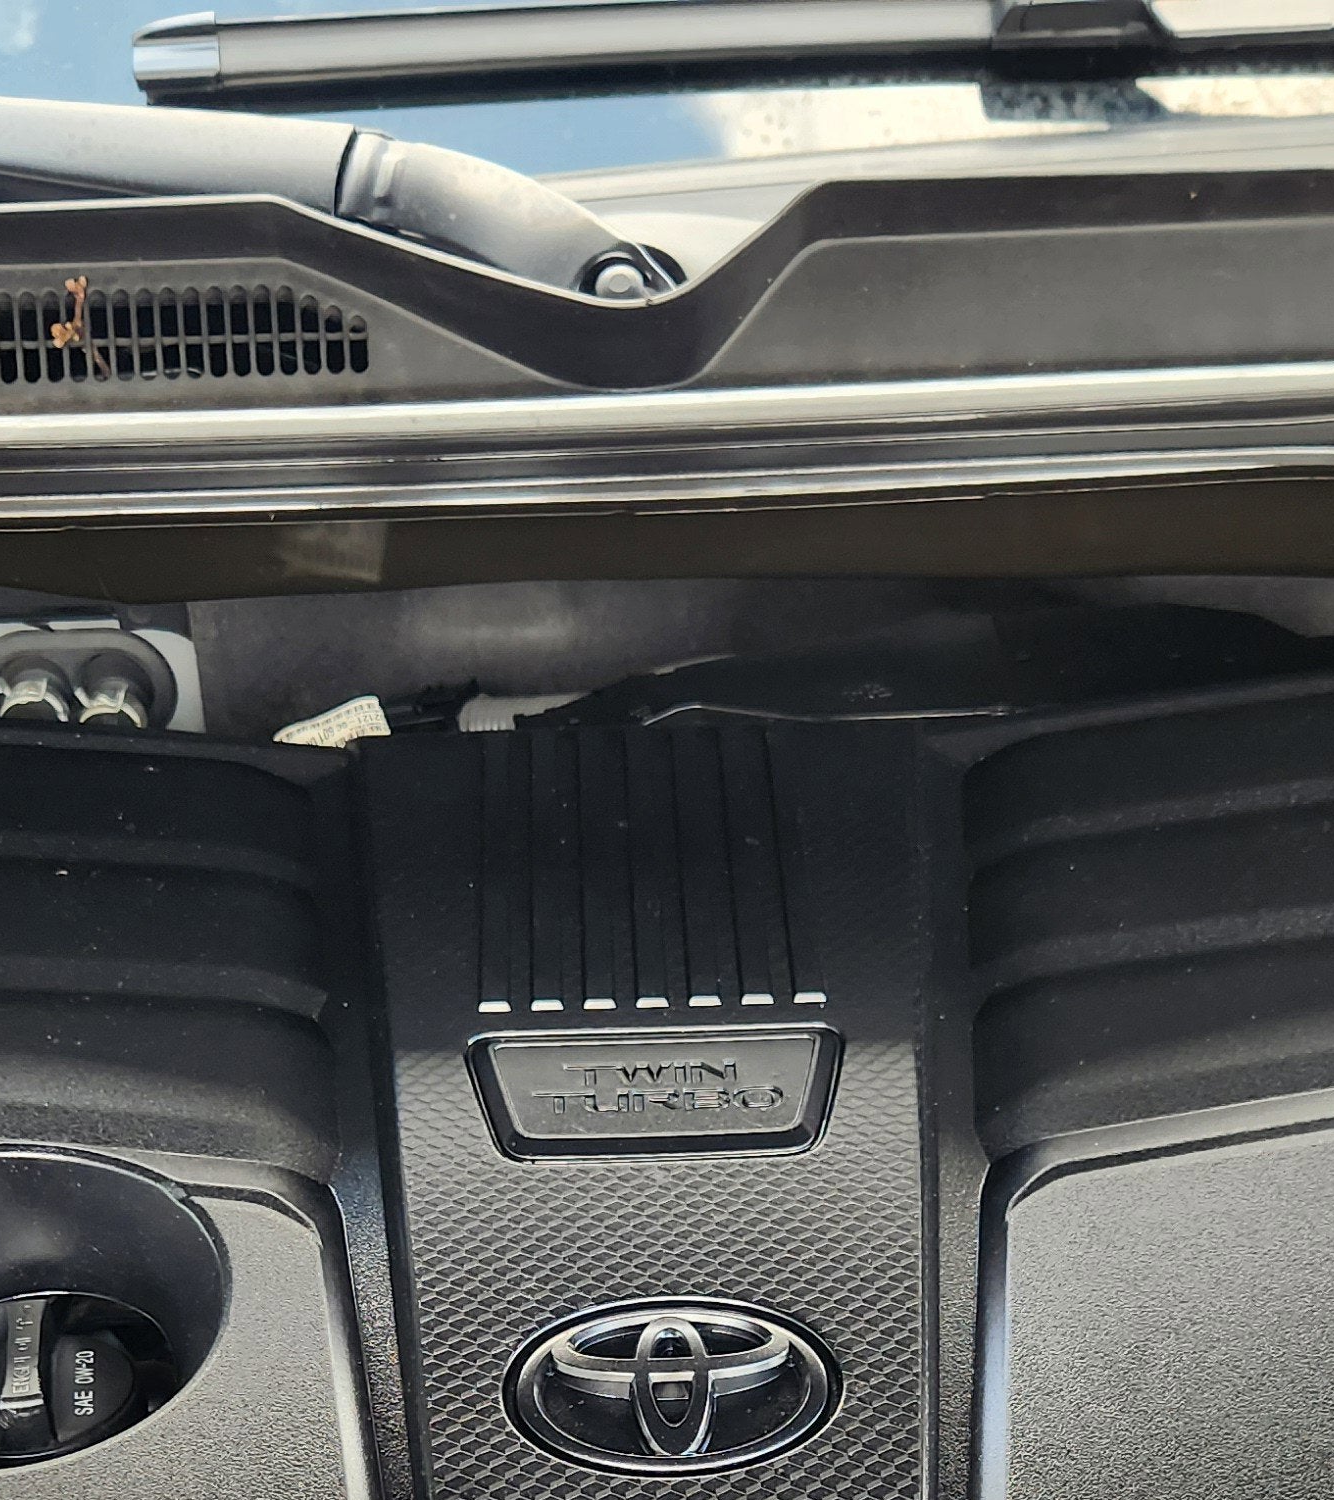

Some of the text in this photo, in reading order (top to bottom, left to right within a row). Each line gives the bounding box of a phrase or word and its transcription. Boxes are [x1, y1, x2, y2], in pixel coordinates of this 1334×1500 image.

[562, 1057, 739, 1087] TWIN
[531, 1084, 786, 1115] TURBO
[75, 1350, 95, 1416] SAE 0W-20
